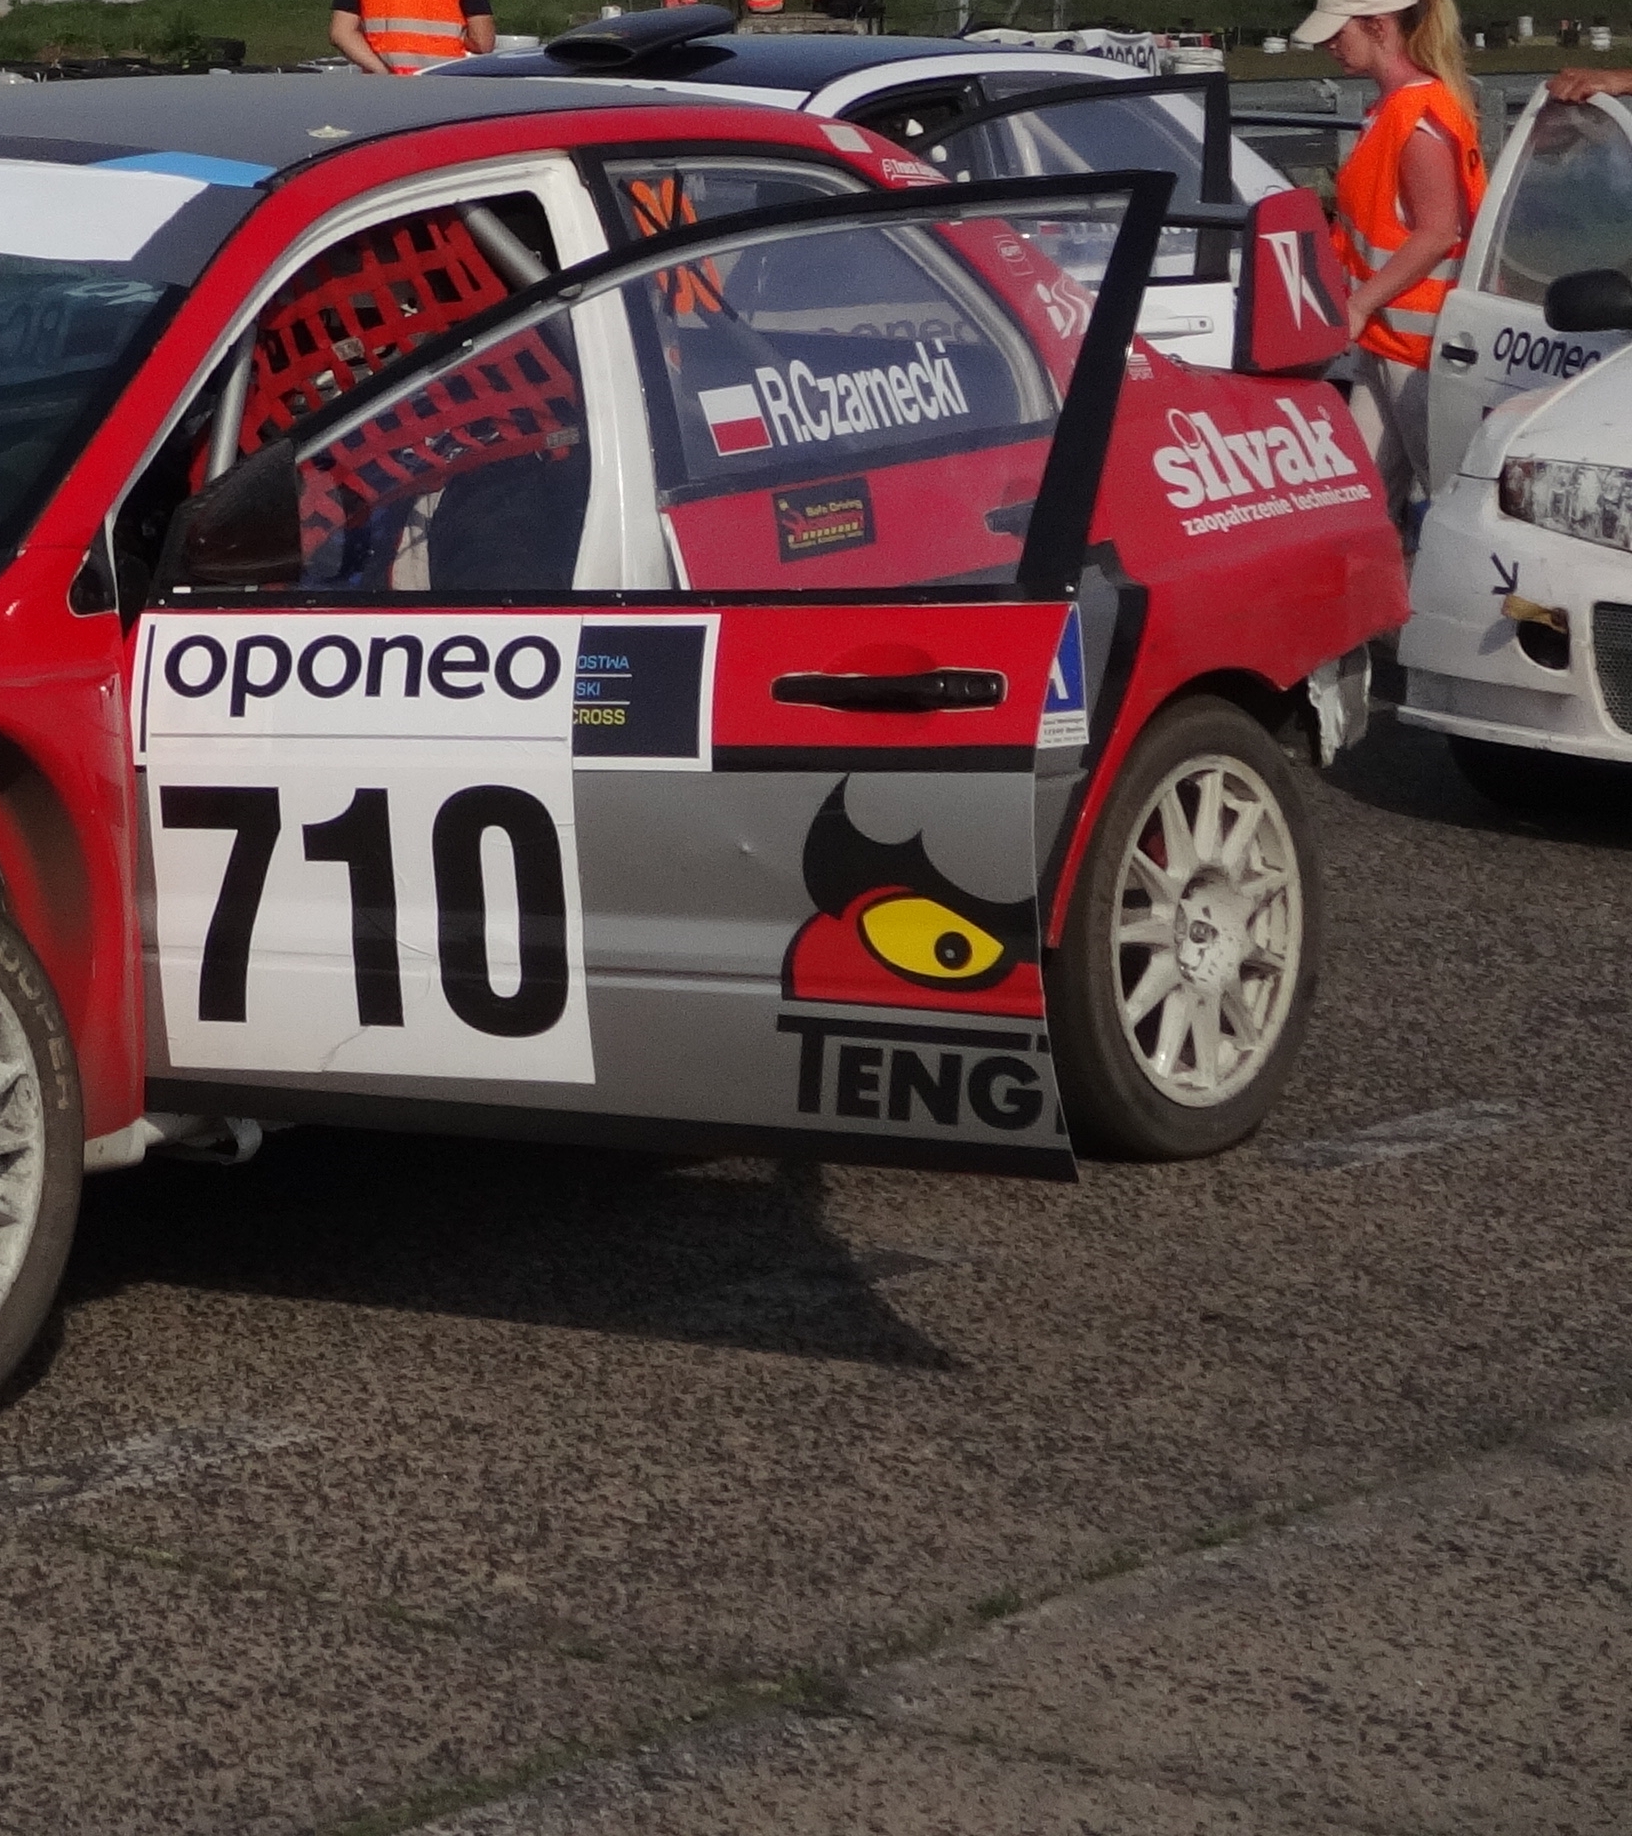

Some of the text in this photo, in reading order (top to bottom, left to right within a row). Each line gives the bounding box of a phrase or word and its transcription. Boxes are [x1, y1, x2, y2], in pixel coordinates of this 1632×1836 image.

[755, 338, 970, 447] R.Czarnecki
[1152, 397, 1358, 510] silvak
[1181, 483, 1372, 536] zaopatrzenie techniczne
[164, 634, 561, 717] oponeo
[159, 784, 570, 1038] 710
